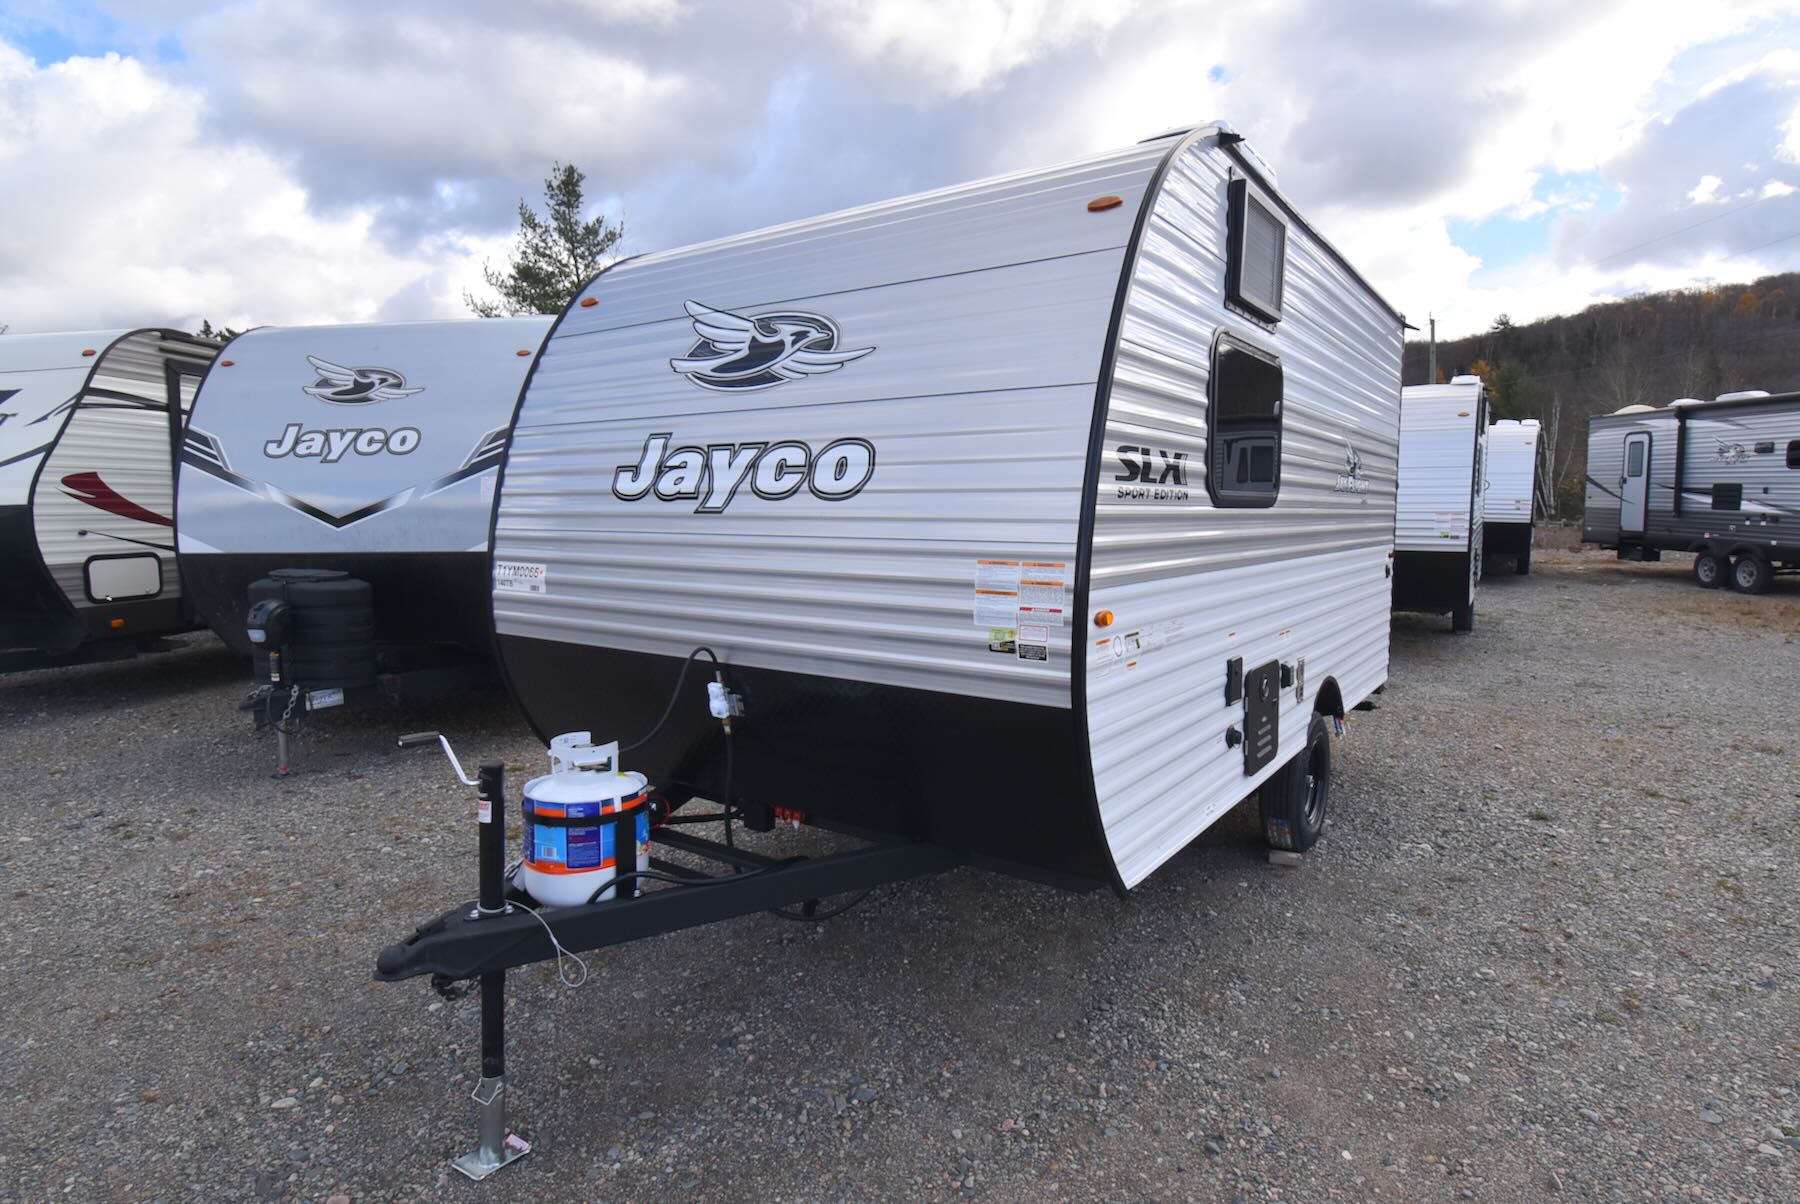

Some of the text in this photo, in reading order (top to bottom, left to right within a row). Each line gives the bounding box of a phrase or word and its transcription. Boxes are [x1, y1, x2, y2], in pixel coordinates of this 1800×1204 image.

[263, 422, 422, 464] Jayco
[611, 432, 876, 514] Jayco
[1115, 445, 1188, 486] SLX
[1117, 486, 1189, 501] SPORT EDITION
